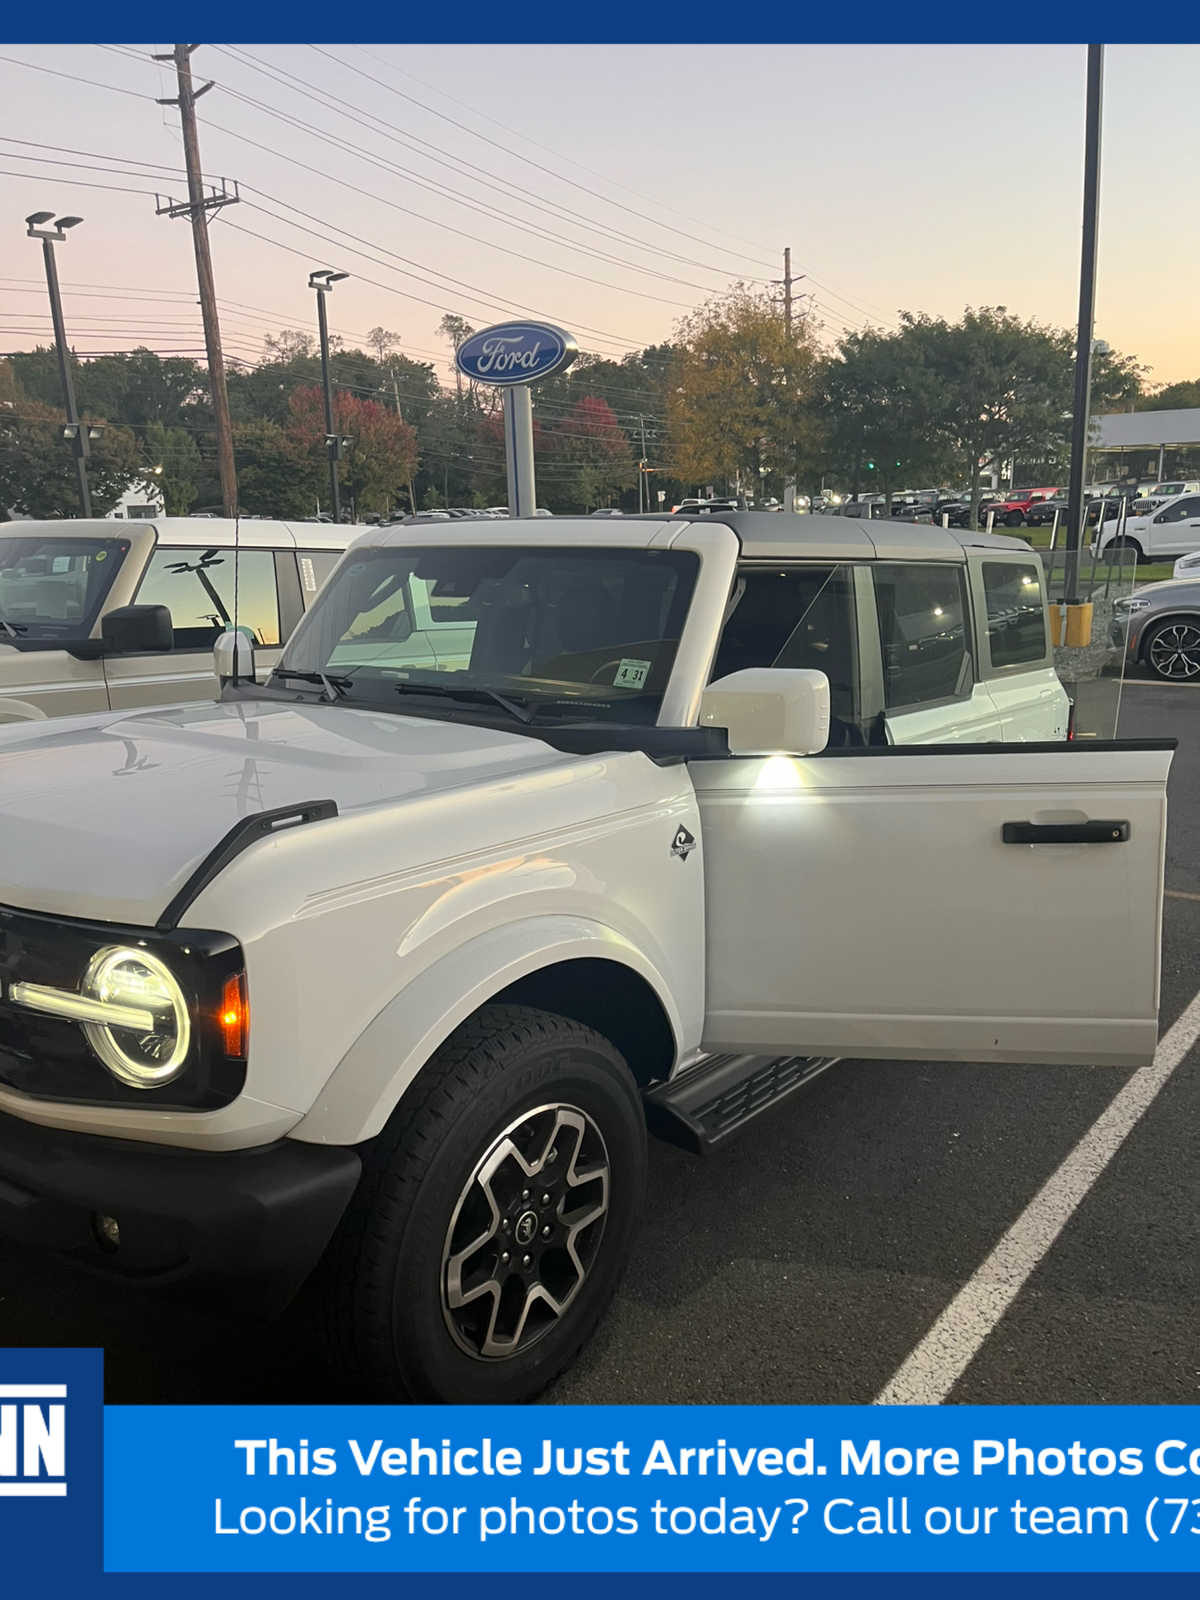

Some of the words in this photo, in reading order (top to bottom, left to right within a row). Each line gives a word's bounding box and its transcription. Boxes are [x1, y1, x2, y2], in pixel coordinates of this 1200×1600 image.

[477, 335, 541, 373] Ford
[621, 668, 628, 680] 4
[632, 669, 644, 681] 31
